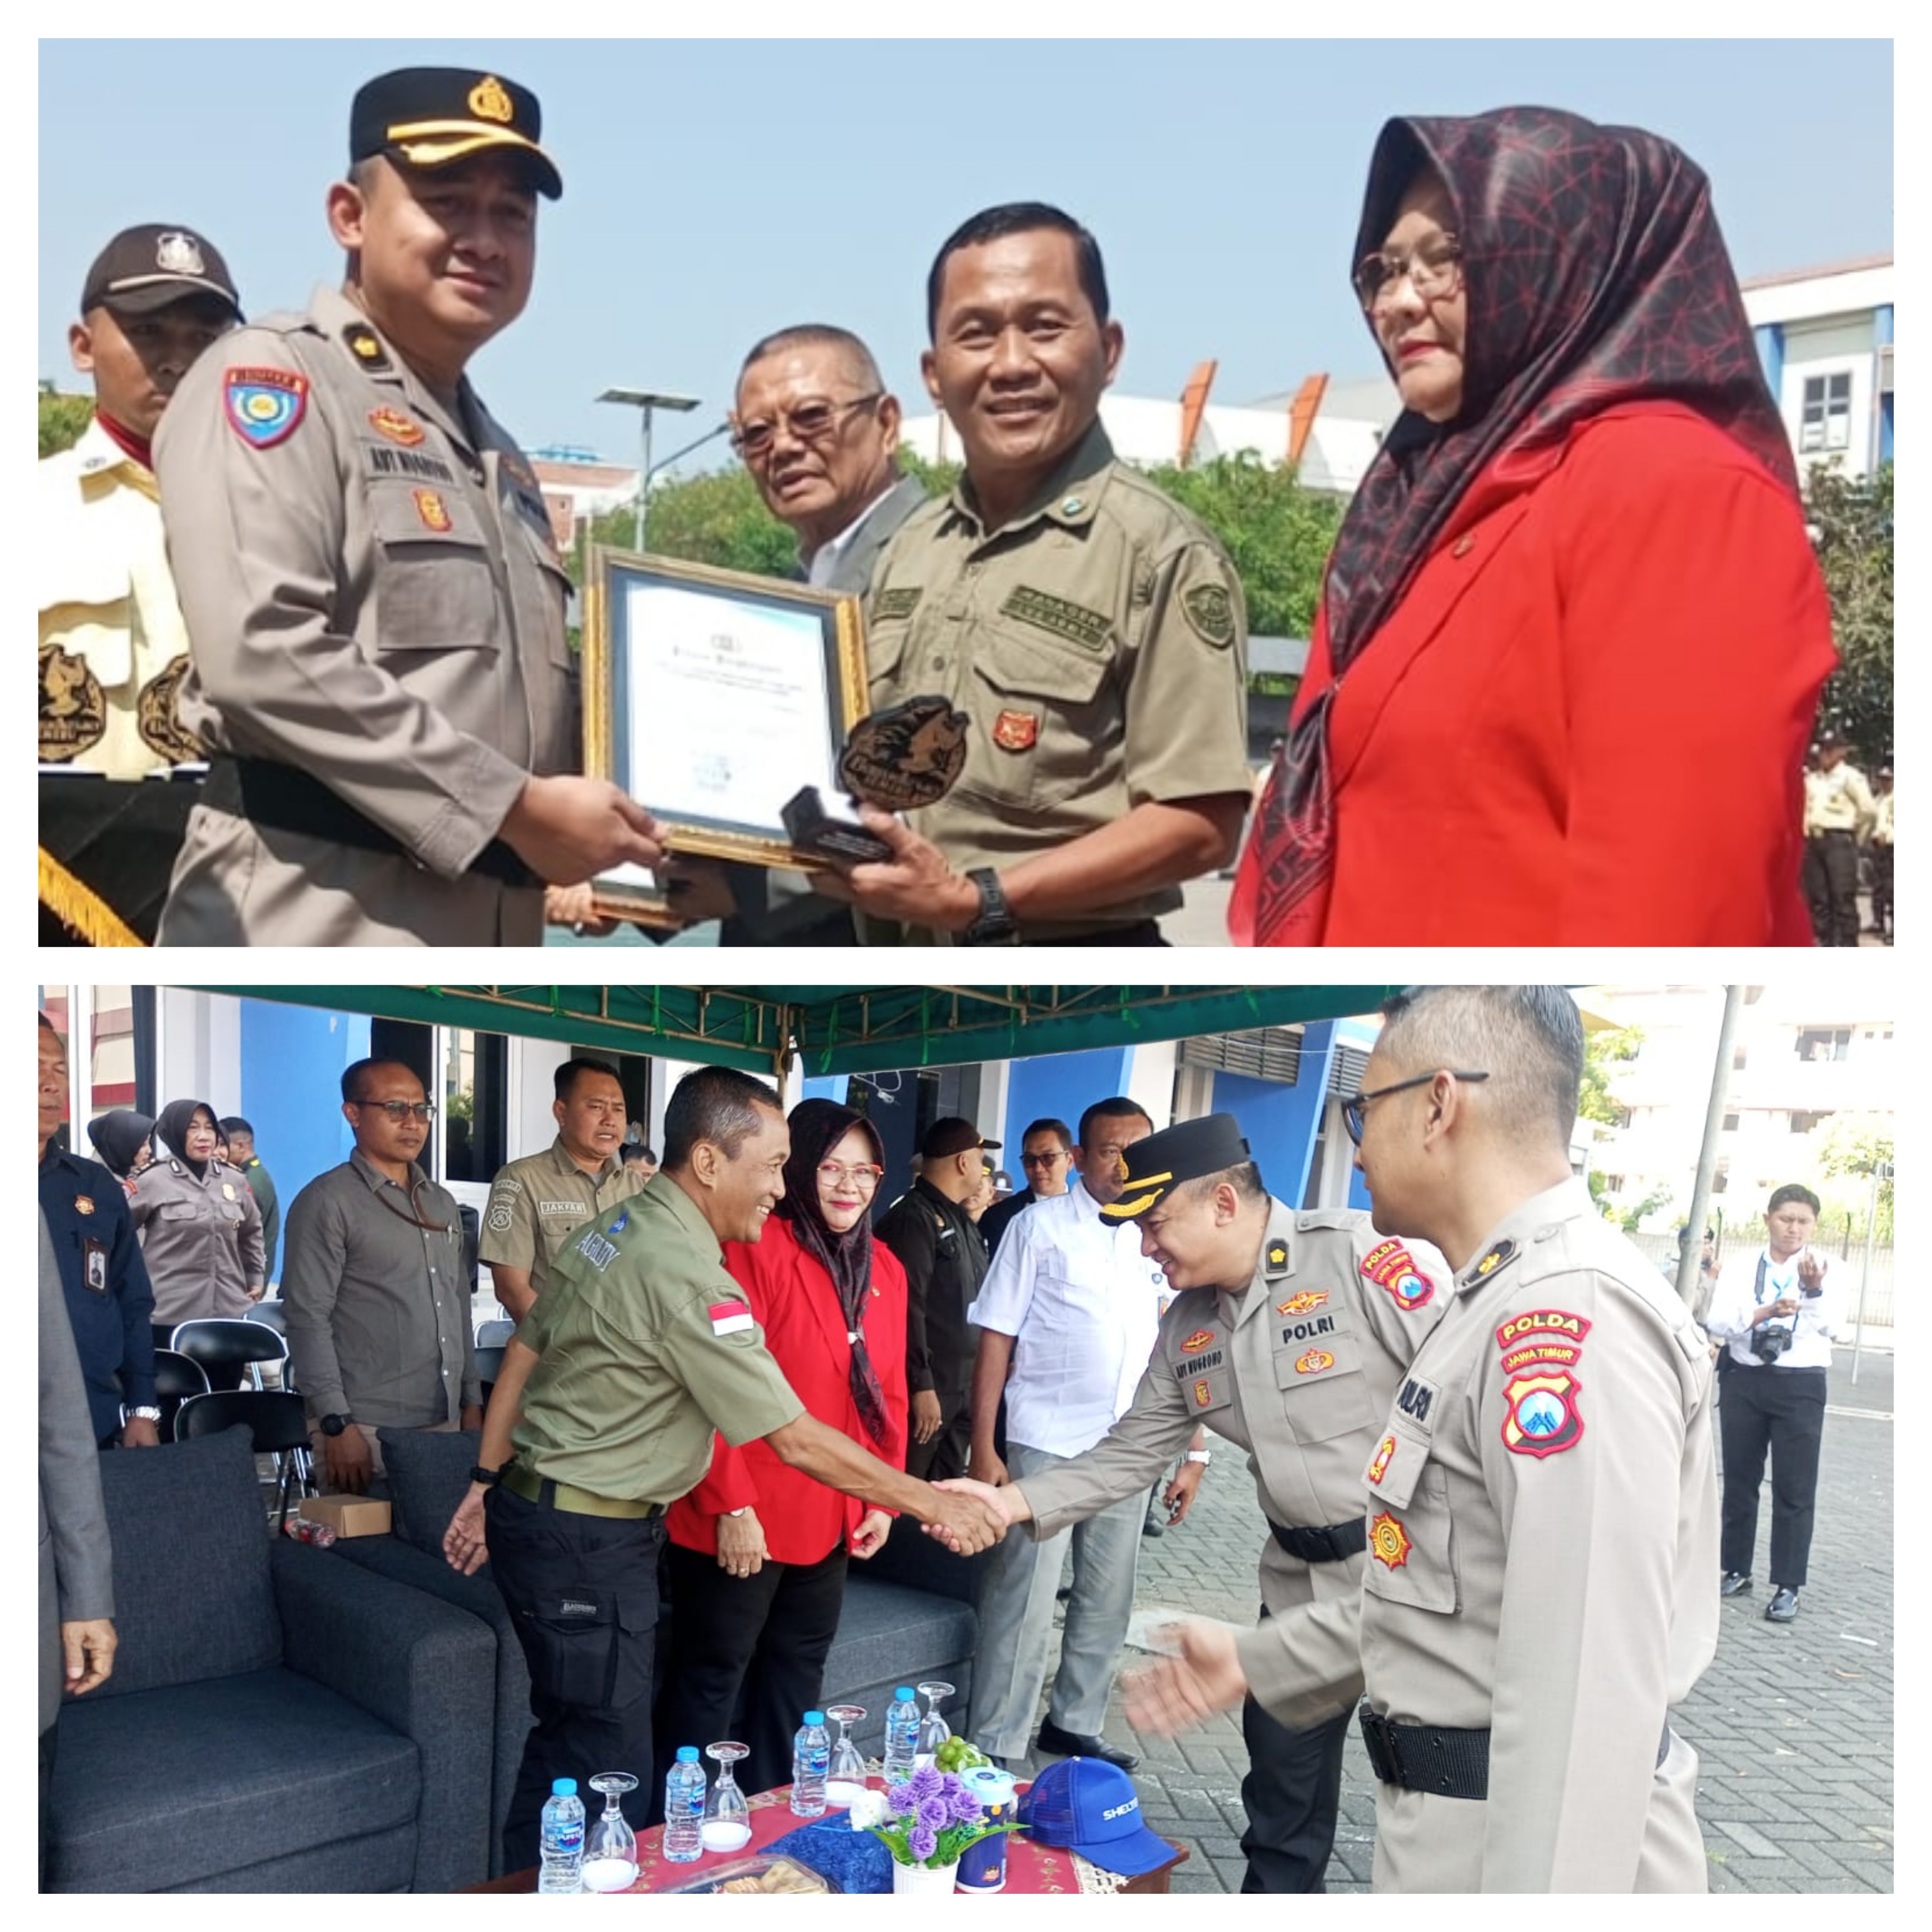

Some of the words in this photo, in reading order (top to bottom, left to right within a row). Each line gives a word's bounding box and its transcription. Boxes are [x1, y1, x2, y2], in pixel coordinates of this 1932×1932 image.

[1365, 1242, 1398, 1270] POLDA
[1282, 1315, 1335, 1344] POLRI
[1503, 1313, 1579, 1341] POLDA
[1507, 1349, 1537, 1368] JAWA
[1536, 1347, 1574, 1361] TIMUR
